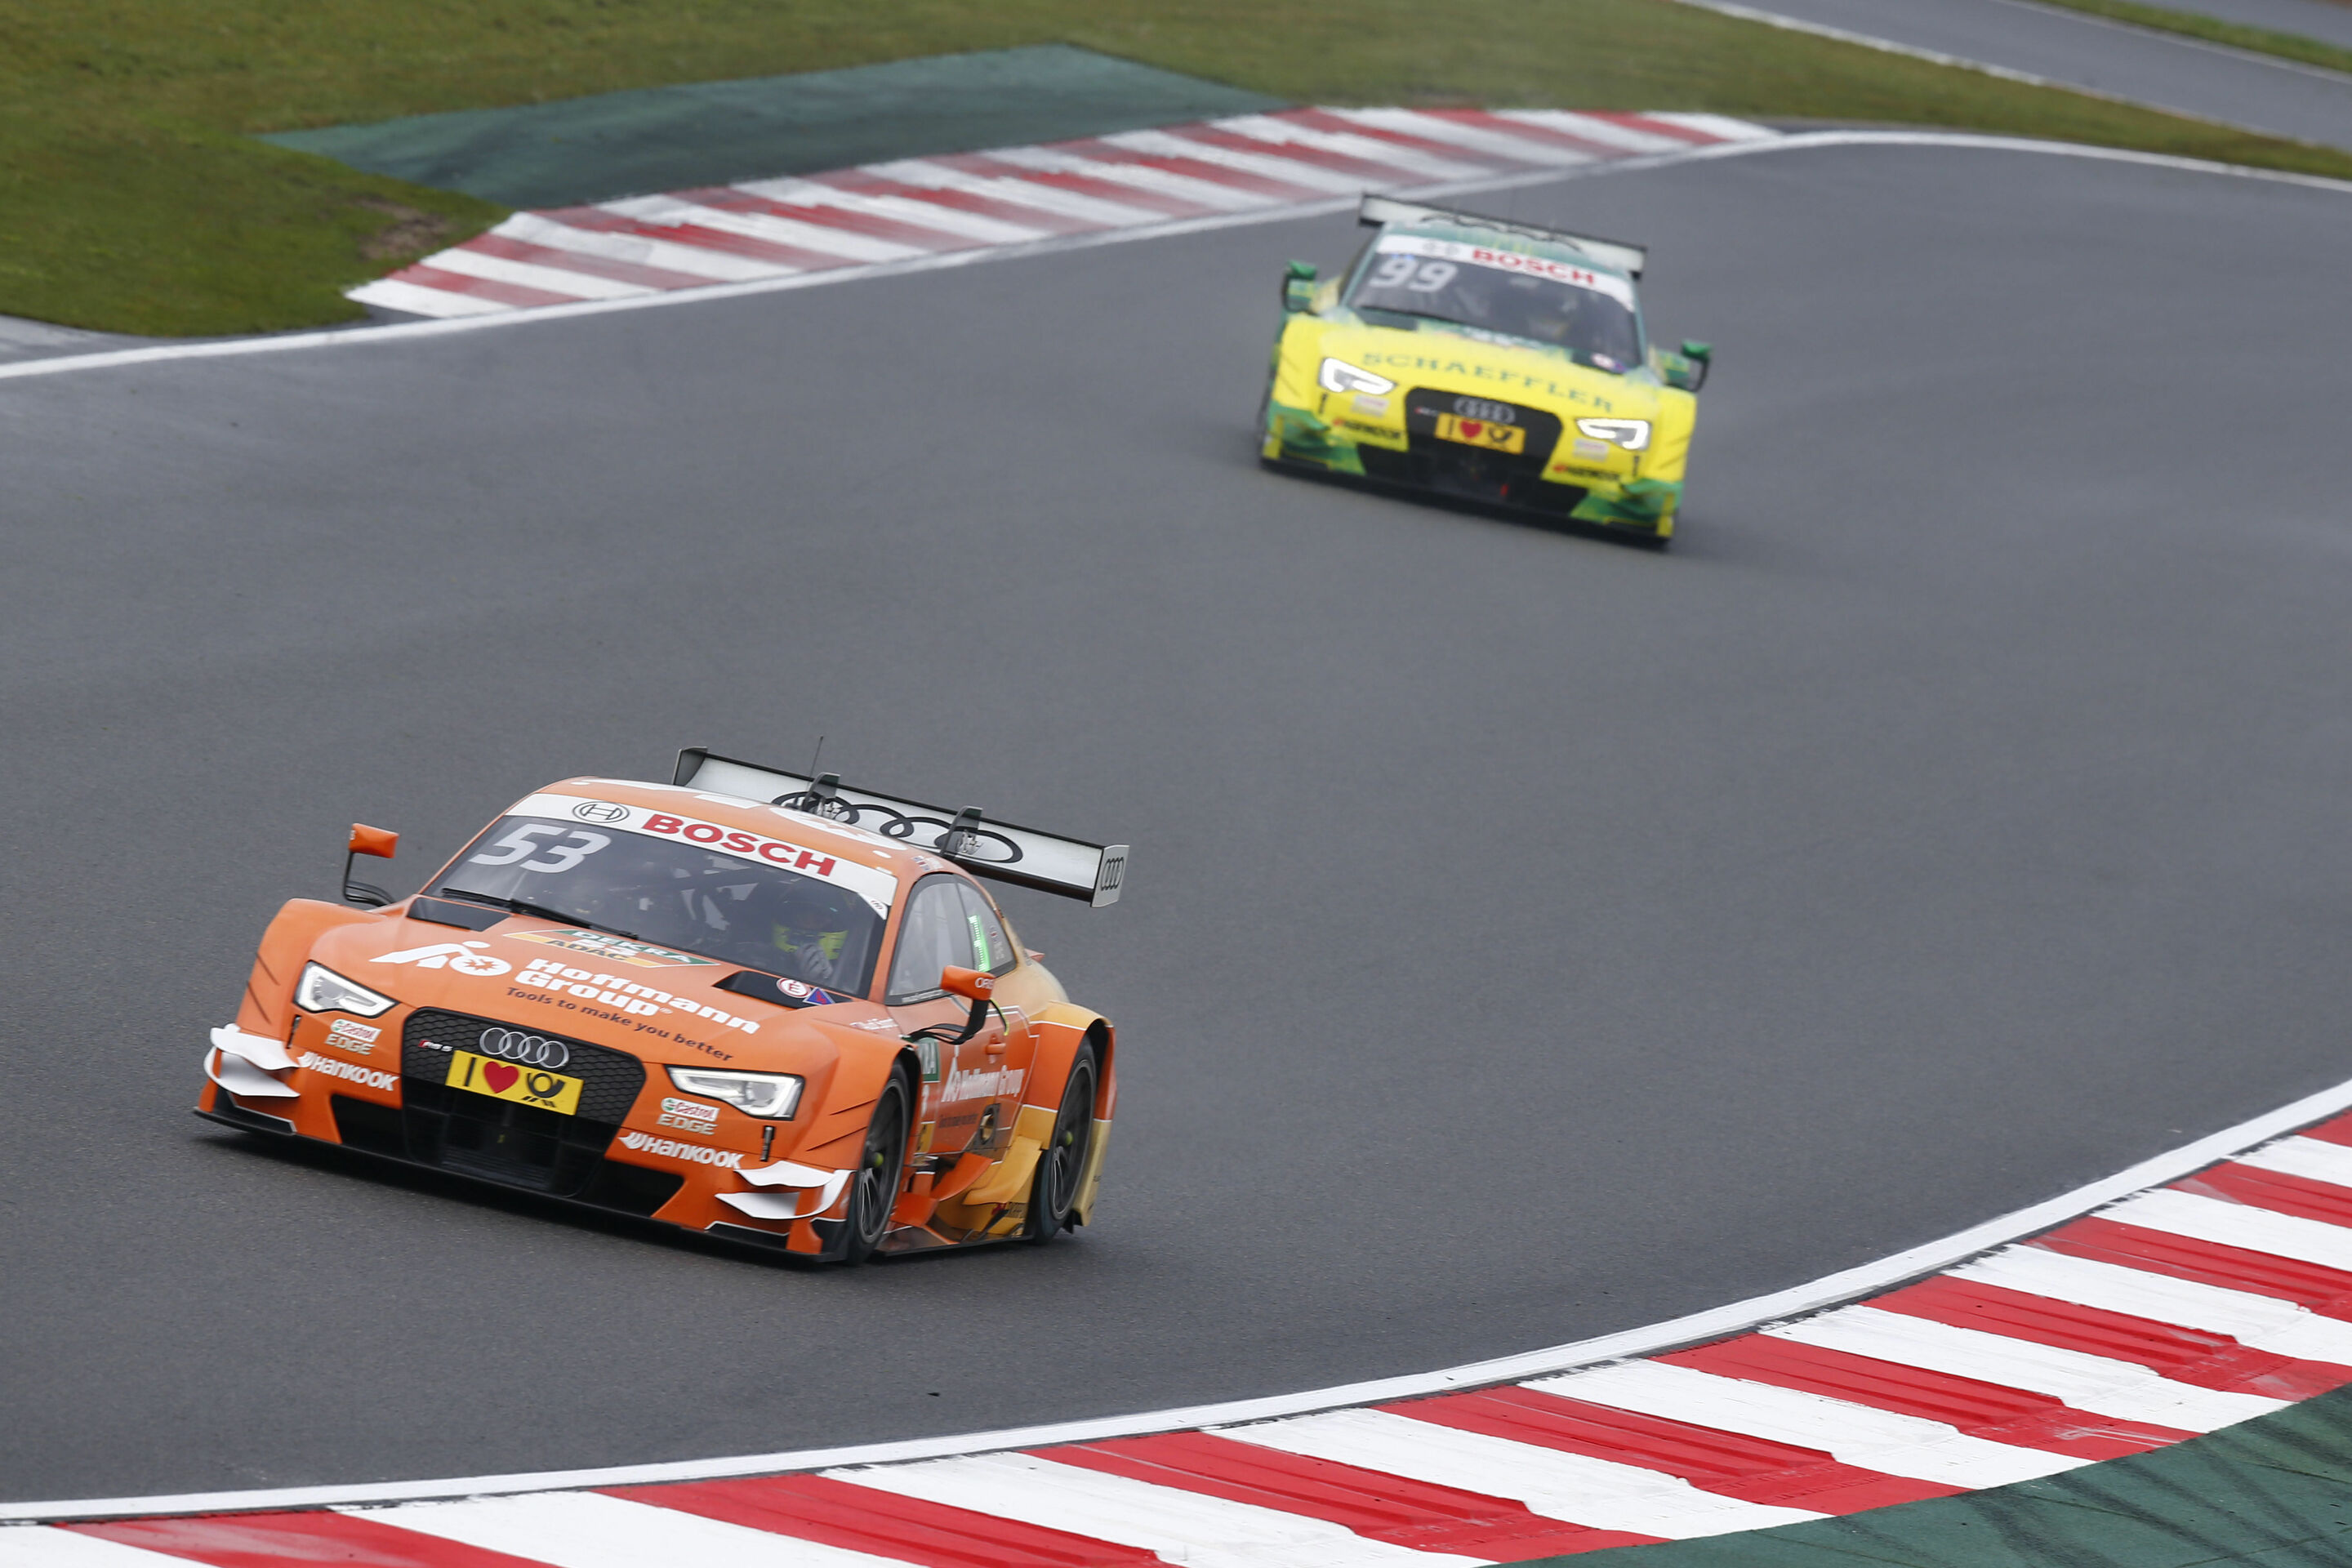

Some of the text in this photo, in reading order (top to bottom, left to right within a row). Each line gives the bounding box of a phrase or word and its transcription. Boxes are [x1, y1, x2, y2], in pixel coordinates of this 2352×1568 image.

[1370, 254, 1458, 292] 99
[1472, 248, 1596, 285] BOSCH
[469, 823, 611, 874] 53
[643, 814, 836, 876] BOSCH
[544, 940, 630, 961] ADAC
[572, 931, 693, 964] DEKRA
[515, 970, 662, 1017] Group
[526, 958, 760, 1035] Hoffmann
[506, 987, 733, 1062] Tools to make you better
[325, 1034, 376, 1055] EDGE
[656, 1114, 718, 1135] EDGE
